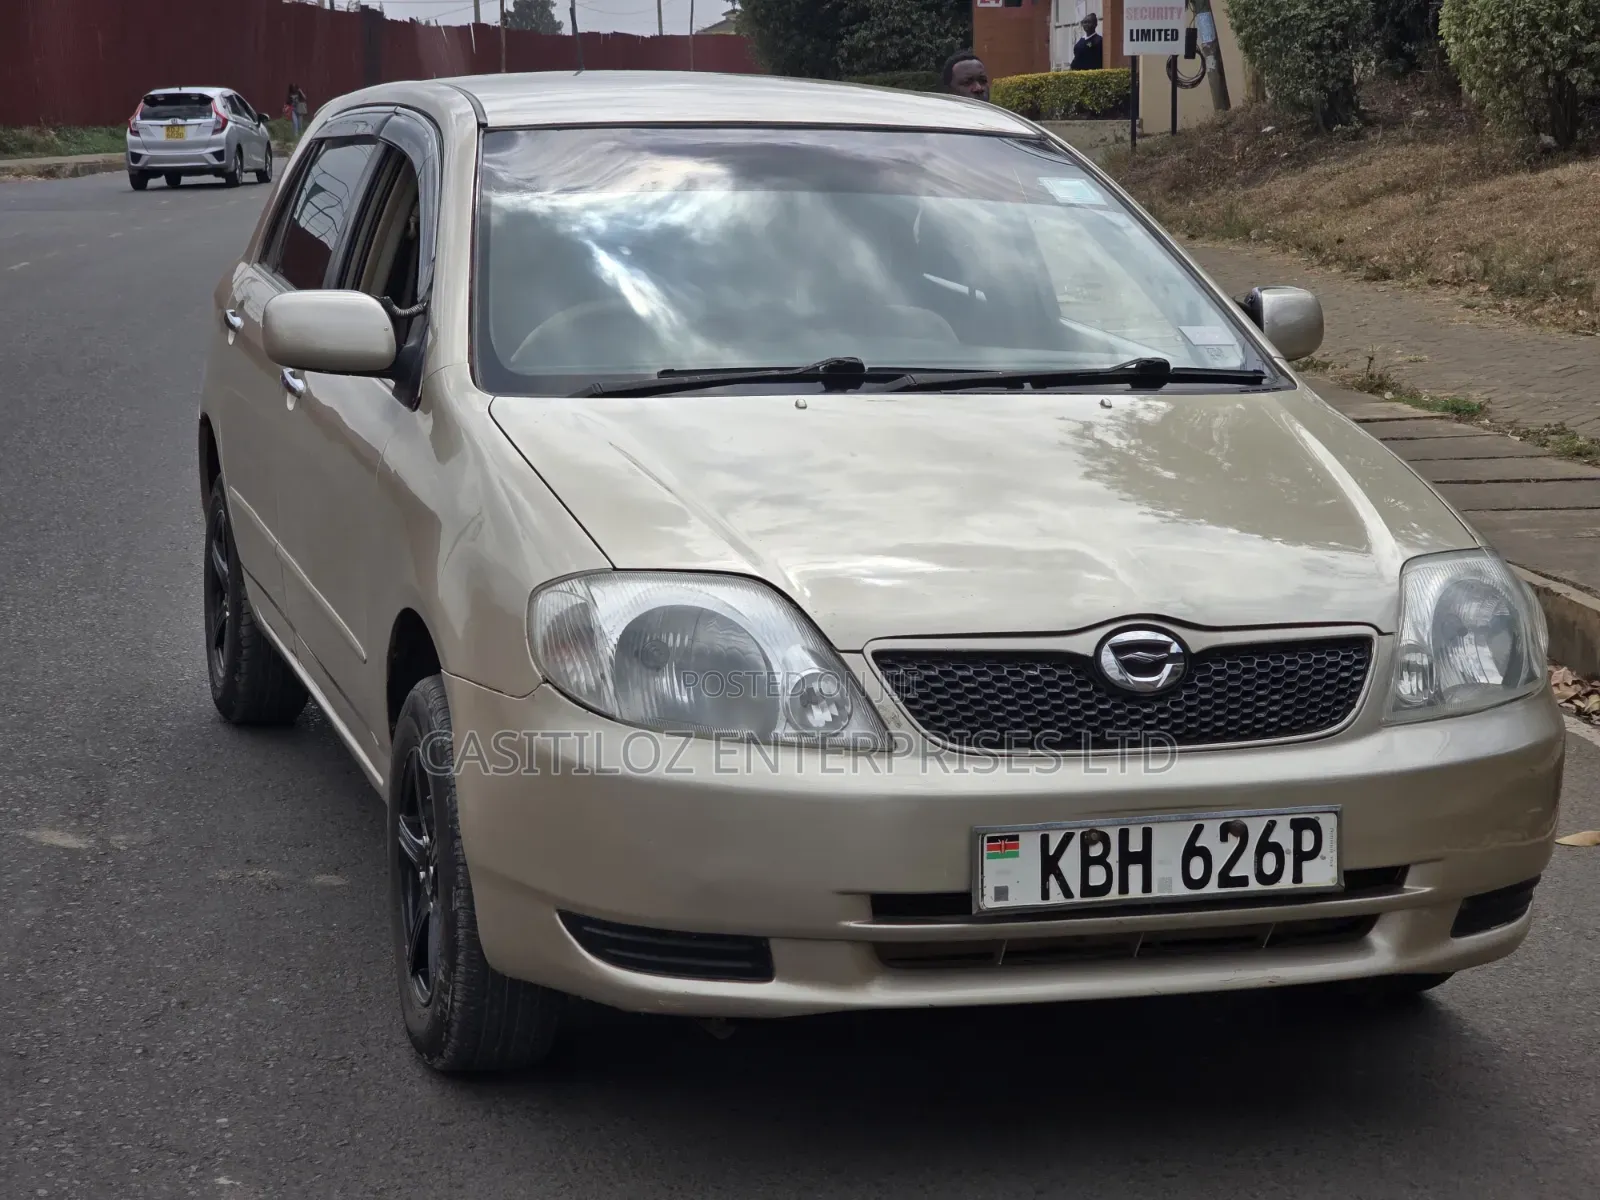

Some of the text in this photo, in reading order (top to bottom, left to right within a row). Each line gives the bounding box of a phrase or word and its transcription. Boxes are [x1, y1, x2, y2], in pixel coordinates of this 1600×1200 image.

[1125, 6, 1183, 20] SECURITY
[1129, 28, 1179, 42] LIMITED
[1040, 826, 1153, 901] KBH
[1180, 816, 1324, 893] 626P
